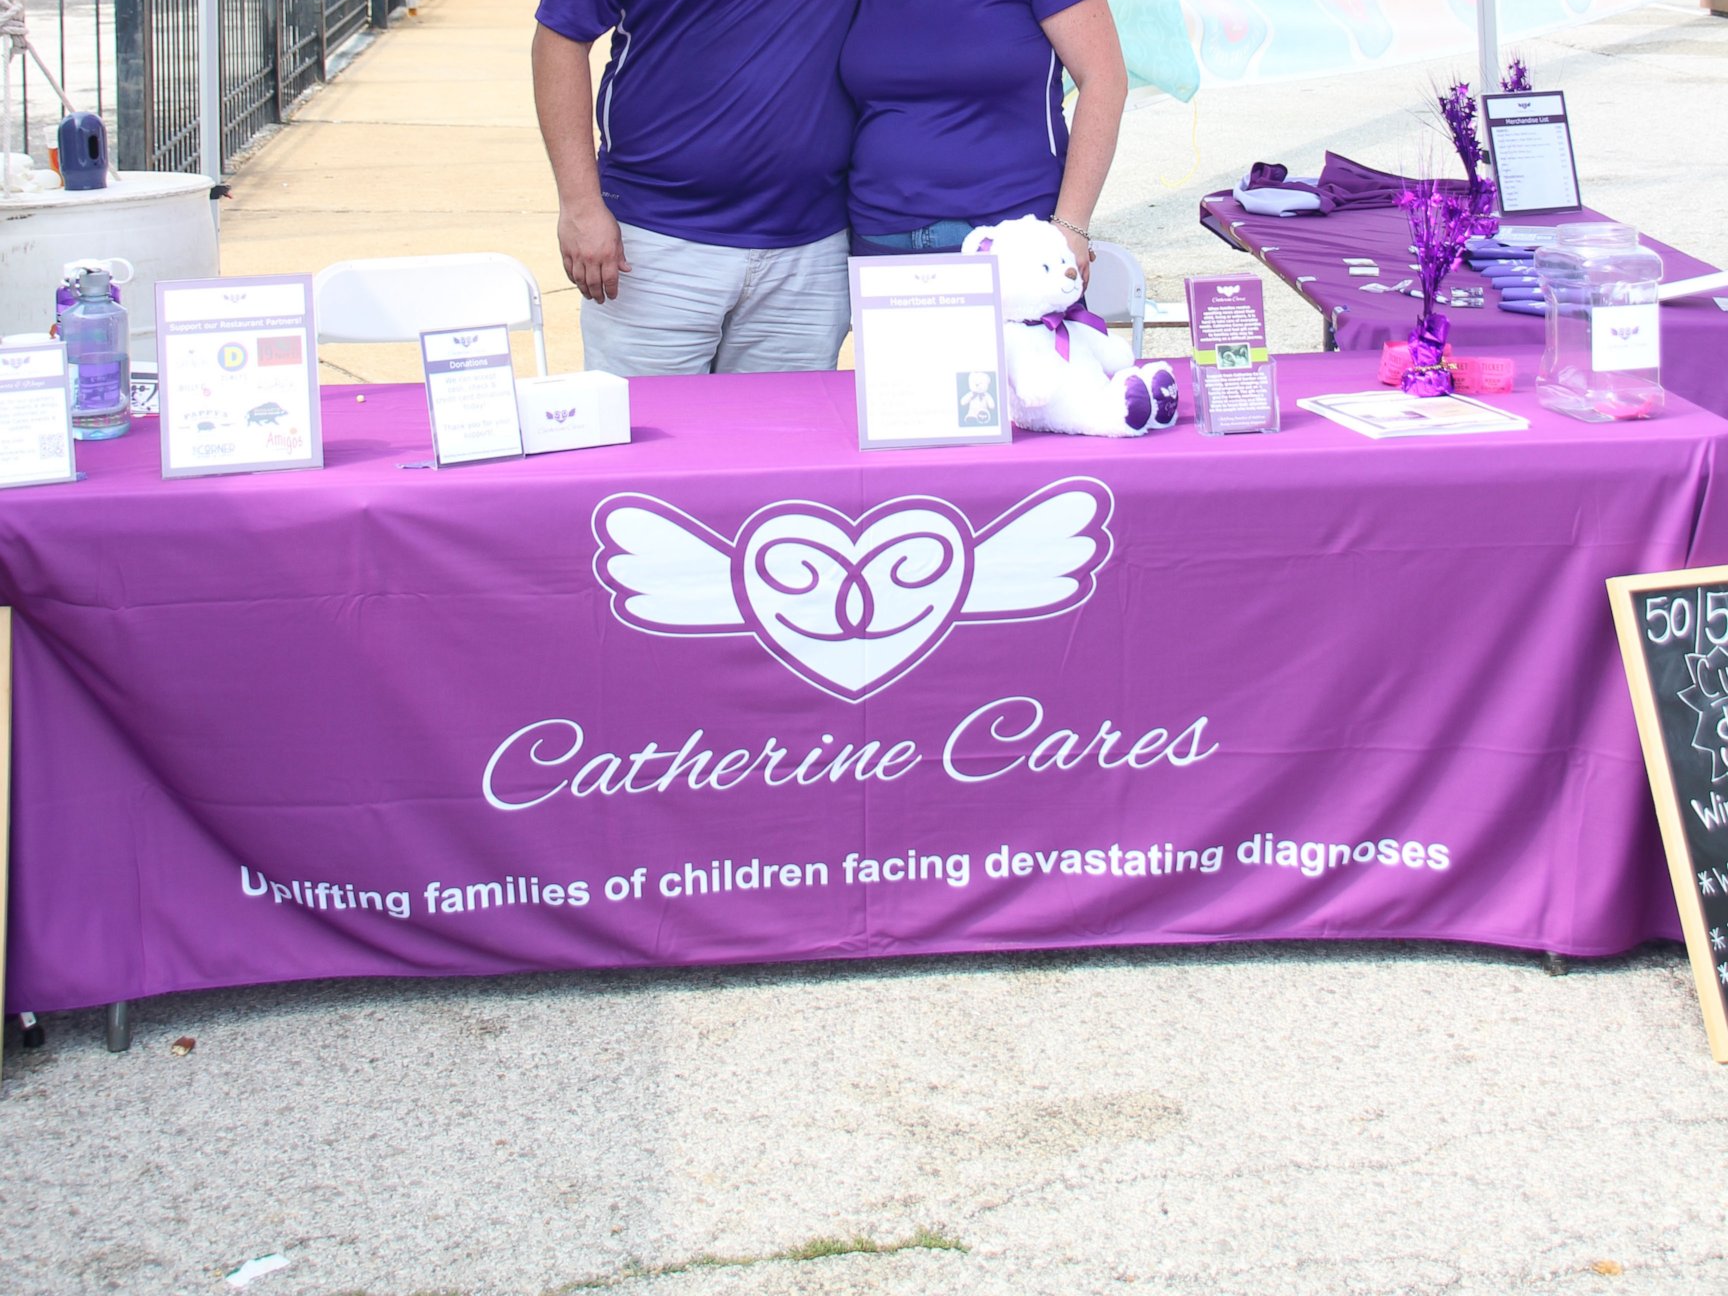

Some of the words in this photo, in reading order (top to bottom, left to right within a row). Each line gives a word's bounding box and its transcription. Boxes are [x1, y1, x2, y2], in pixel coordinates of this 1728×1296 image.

[1505, 117, 1539, 125] Merchandise
[890, 296, 936, 306] Heartbeat
[939, 296, 965, 304] Bears
[169, 322, 202, 332] Support
[220, 319, 263, 329] Restaurant
[266, 316, 302, 326] Partners!
[449, 358, 488, 369] Donations
[266, 431, 303, 455] Amigos
[481, 718, 922, 811] Catherine
[942, 695, 1220, 783] Cares
[240, 863, 412, 919] Uplifting
[423, 875, 591, 914] families
[604, 866, 648, 902] of
[658, 857, 830, 897] children
[842, 848, 971, 887] facing
[984, 842, 1224, 879] devastating
[1236, 832, 1451, 877] diagnoses
